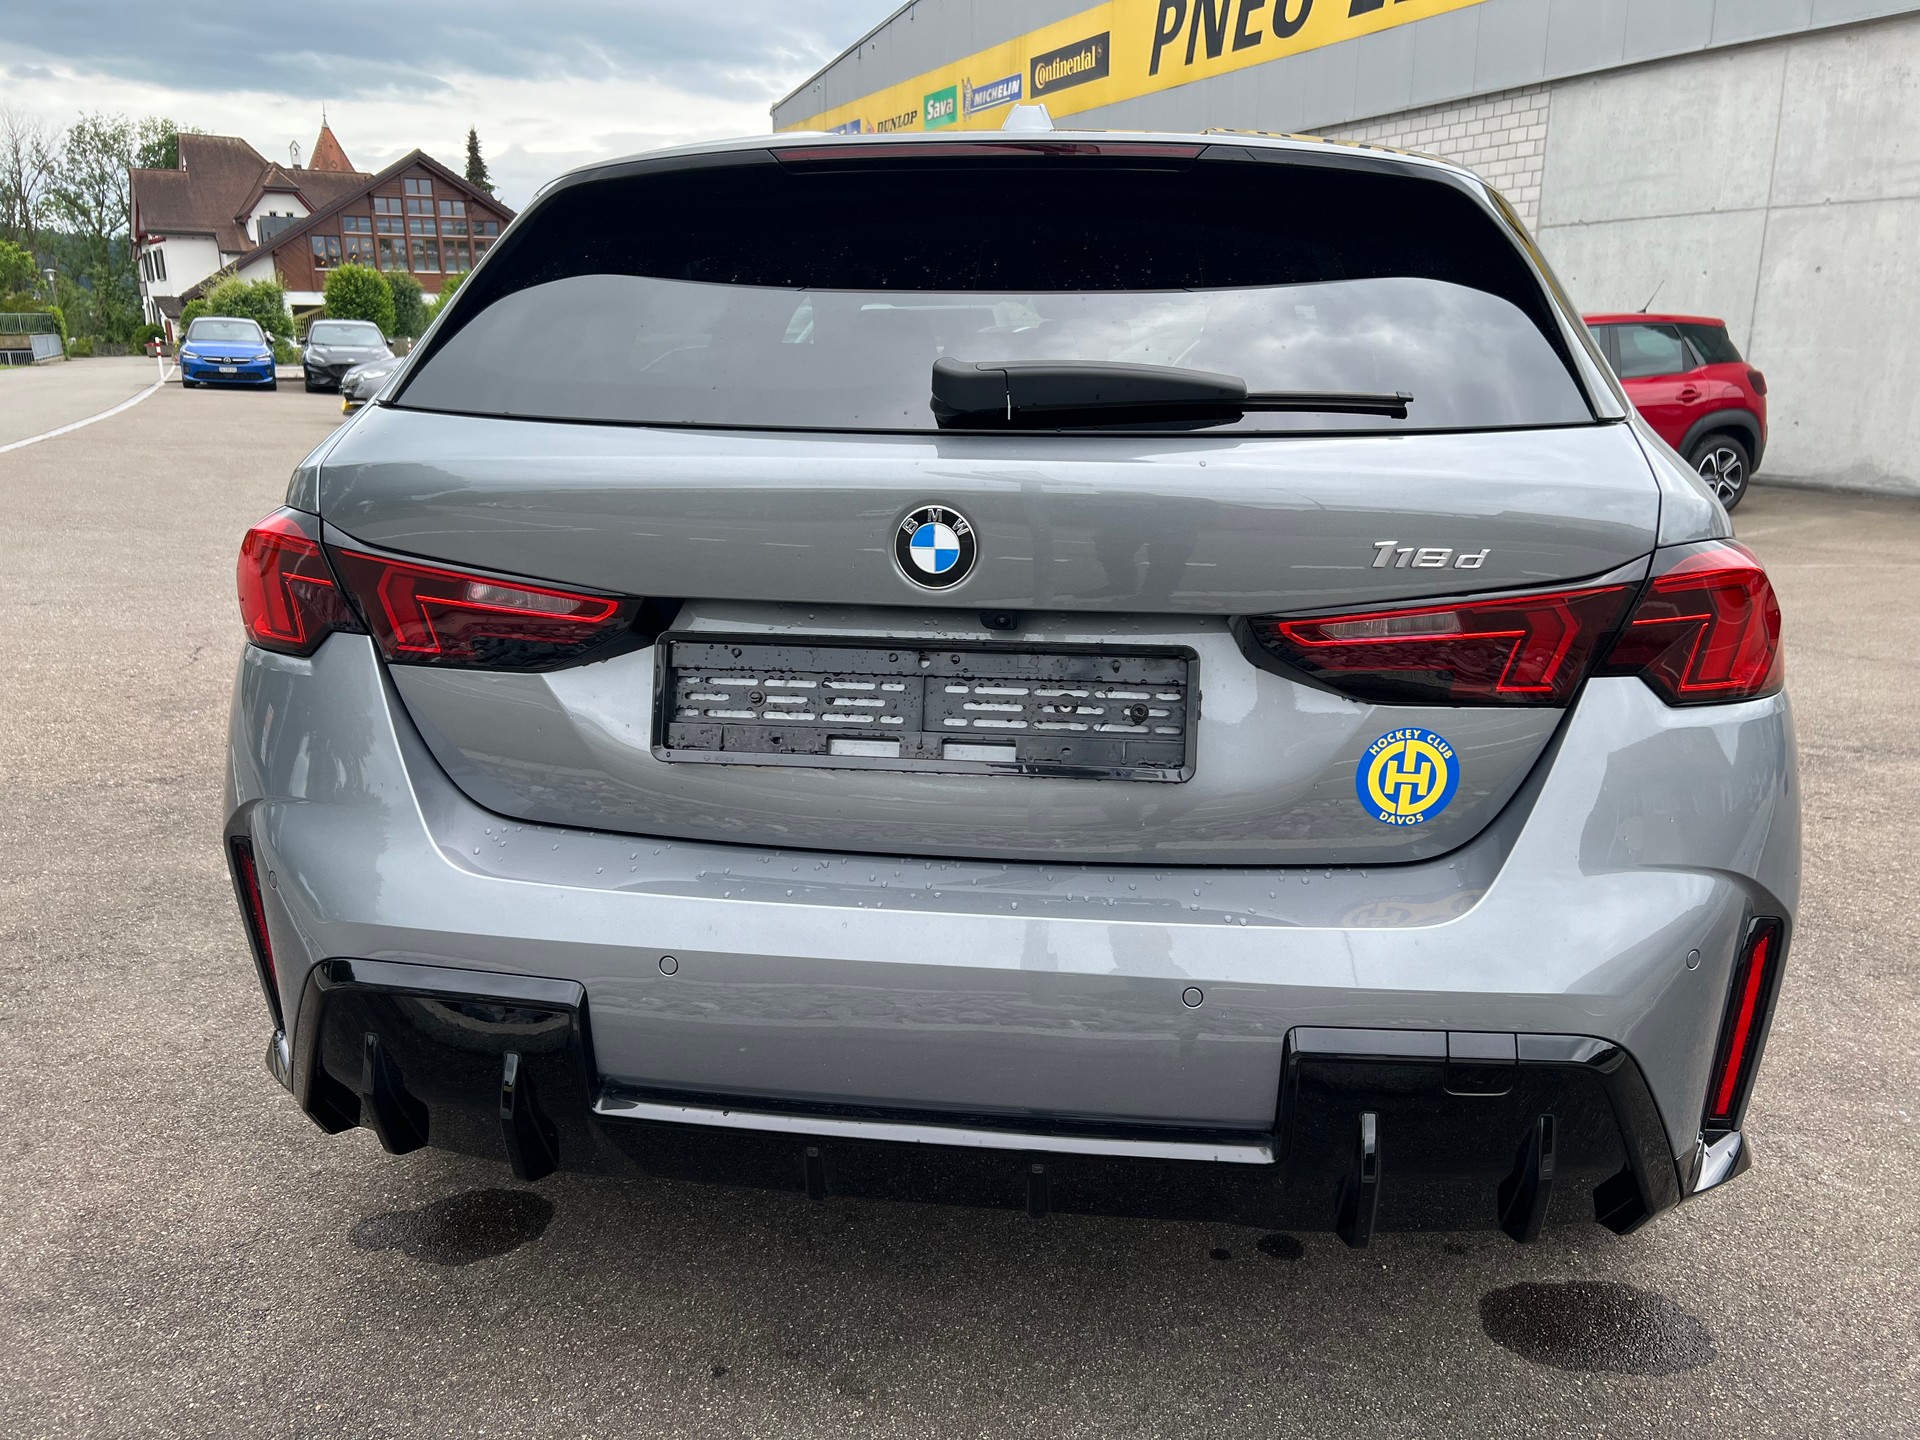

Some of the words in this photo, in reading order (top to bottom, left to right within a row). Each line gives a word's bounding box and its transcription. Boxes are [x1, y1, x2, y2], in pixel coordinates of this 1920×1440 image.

[1034, 45, 1096, 89] Continental
[973, 79, 1020, 106] MICHELIN
[878, 110, 918, 132] DUNLOP
[926, 97, 954, 121] Sava
[902, 508, 970, 536] BMW
[1369, 729, 1422, 756] HOCKEY
[1427, 734, 1453, 759] CLUB
[1379, 811, 1424, 825] DAVOS
